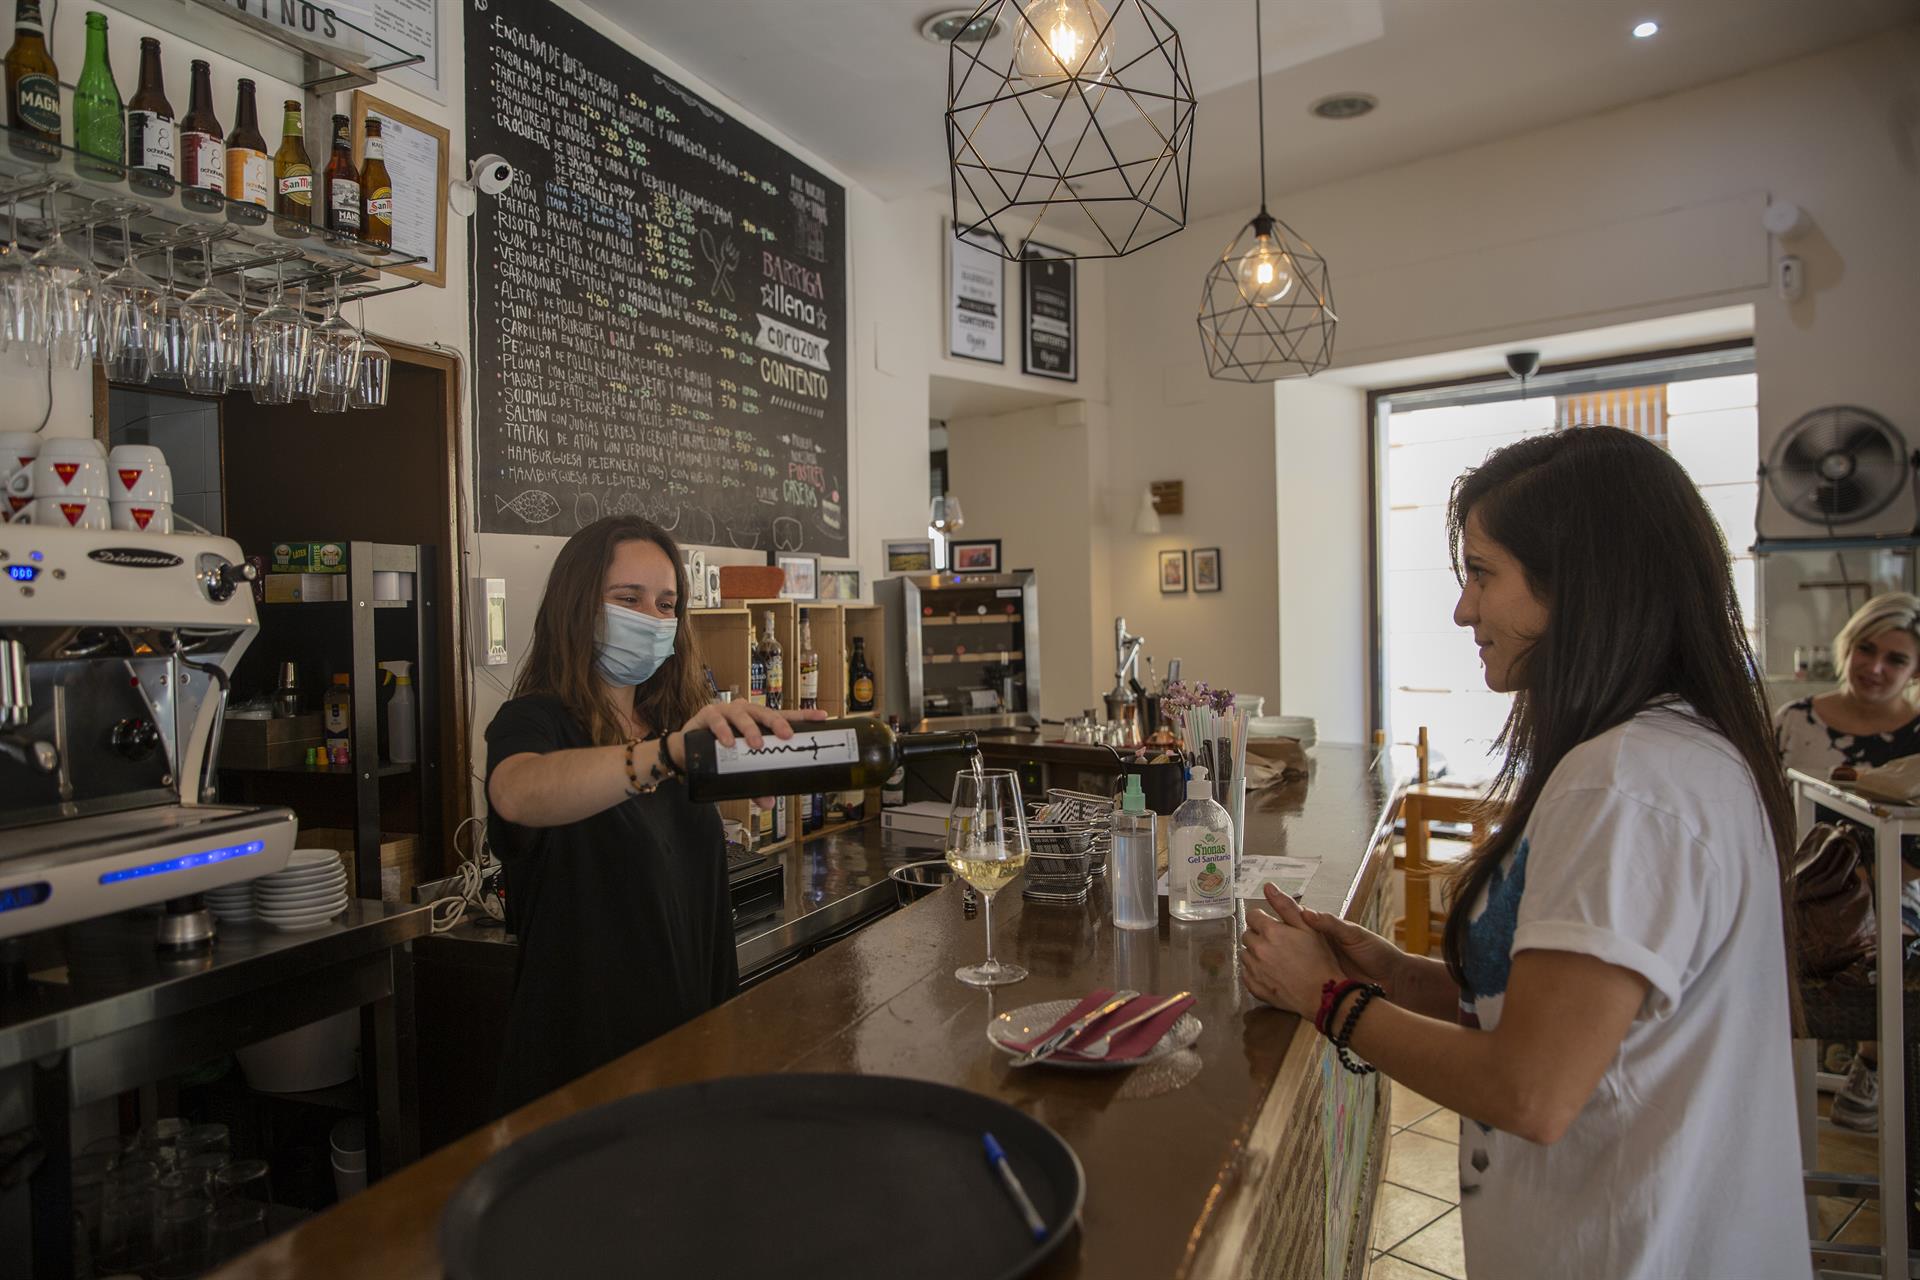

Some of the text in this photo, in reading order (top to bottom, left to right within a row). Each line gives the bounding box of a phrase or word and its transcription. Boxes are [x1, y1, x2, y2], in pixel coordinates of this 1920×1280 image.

[495, 15, 547, 64] ENSALADA
[549, 44, 561, 70] DE
[562, 52, 586, 84] QUESO
[494, 62, 530, 90] TARTAR
[532, 82, 543, 95] DE
[496, 46, 543, 84] ENSALADA
[545, 71, 557, 86] DE
[559, 77, 617, 122] LANGOSTINOS
[496, 79, 548, 115] ENSALADILLA
[551, 106, 560, 118] DE
[563, 109, 587, 131] PULPO
[496, 95, 551, 132] SALMOREJO
[497, 111, 550, 150] CROQUETAS
[554, 139, 563, 152] DE
[566, 142, 591, 167] QUESO
[632, 168, 638, 180] Y
[554, 151, 566, 164] DE
[280, 179, 300, 193] San
[512, 168, 531, 189] ESO
[555, 163, 568, 176] DE
[568, 163, 595, 189] POLLO
[598, 177, 609, 190] AL
[556, 171, 569, 187] DE
[617, 197, 624, 210] Y
[369, 200, 386, 213] San
[498, 210, 538, 239] RISOTTO
[542, 228, 552, 240] DE
[555, 231, 583, 254] SETAS
[587, 242, 593, 258] Y
[547, 209, 583, 237] BRAVAS
[586, 227, 603, 243] CON
[499, 230, 527, 251] WOK
[532, 242, 544, 253] DE
[546, 243, 606, 279] TALLARINES
[499, 242, 551, 273] VERDURAS
[554, 263, 569, 279] EN
[500, 260, 562, 295] GABARDINAS
[763, 251, 824, 300] BARRIGA
[501, 280, 538, 307] ALITAS
[544, 296, 554, 309] DE
[556, 297, 583, 317] POLLO
[588, 306, 604, 322] CON
[775, 284, 815, 324] llena
[501, 317, 558, 342] CARRILLADA
[561, 334, 573, 347] EN
[575, 336, 599, 358] SALSA
[502, 333, 551, 360] PECHUGA
[555, 350, 565, 363] DE
[567, 351, 593, 372] POLLO
[669, 381, 674, 399] Y
[503, 353, 541, 373] PLUMA
[548, 364, 565, 380] CON
[503, 366, 544, 391] MAGRET
[548, 379, 561, 391] DE
[563, 380, 584, 399] PATO
[760, 357, 828, 399] CONTENTO
[504, 380, 557, 408] SOLOMILLO
[560, 397, 572, 408] DE
[573, 398, 617, 427] TERNERA
[504, 418, 549, 446] TATAKI
[557, 432, 568, 445] DE
[666, 449, 672, 466] Y
[551, 413, 567, 426] CON
[640, 426, 645, 443] Y
[508, 444, 582, 468] HAMBURGUESA
[588, 457, 600, 469] DE
[599, 457, 639, 474] TERNERA
[509, 465, 588, 485] HAMBURGUESA
[591, 473, 605, 485] DE
[606, 472, 651, 490] LENTEJAS
[1187, 856, 1201, 864] Gel
[1194, 843, 1226, 856] S'nonas
